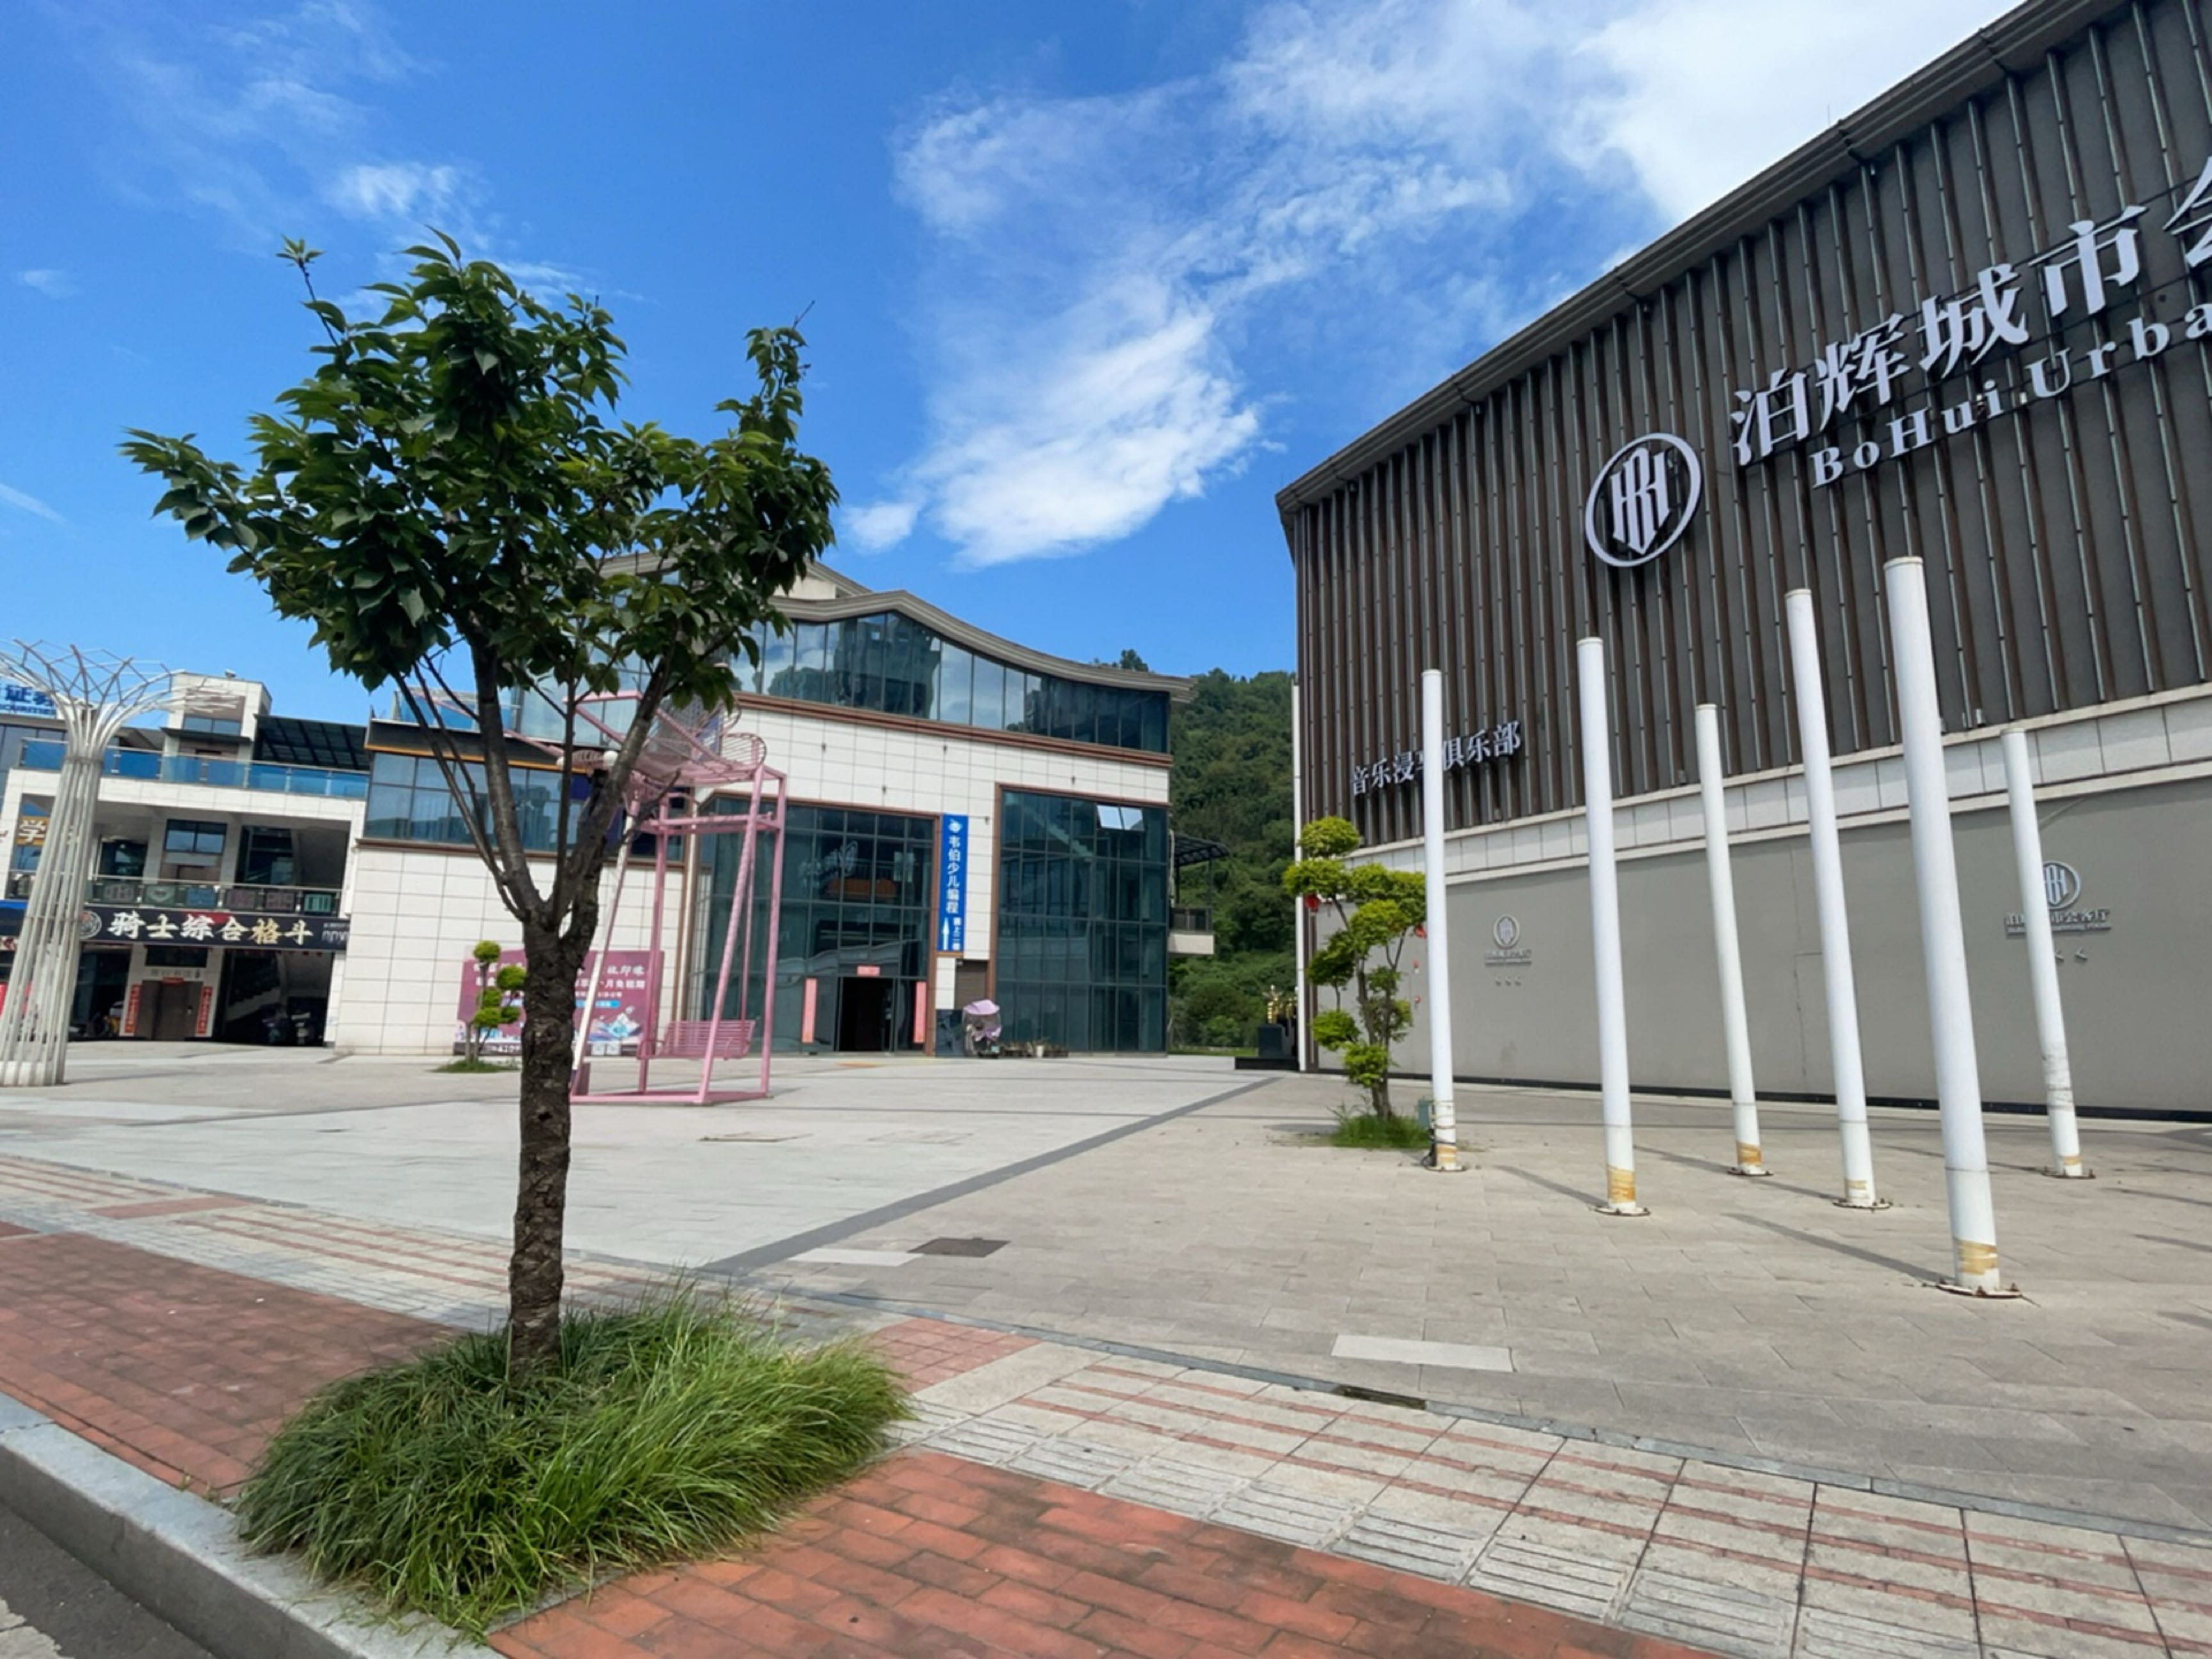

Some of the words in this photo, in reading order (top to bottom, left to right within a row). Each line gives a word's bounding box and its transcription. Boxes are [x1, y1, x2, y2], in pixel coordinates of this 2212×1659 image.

[1811, 378, 2004, 490] BoHui
[107, 910, 314, 945] 骑士综合格斗
